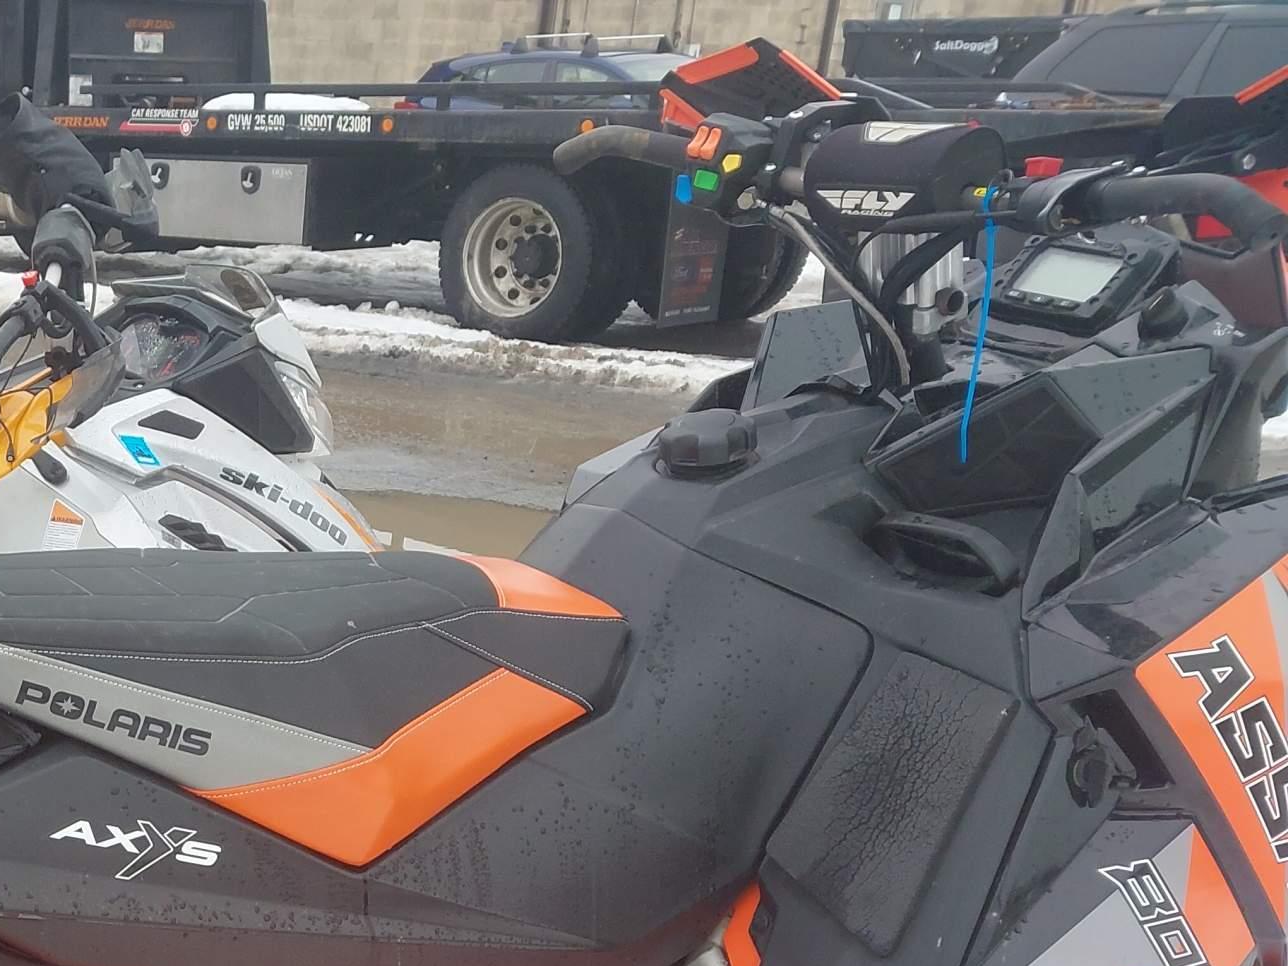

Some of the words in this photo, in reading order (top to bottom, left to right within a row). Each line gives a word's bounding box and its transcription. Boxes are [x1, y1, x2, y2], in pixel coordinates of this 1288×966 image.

[131, 108, 144, 118] CAT
[145, 108, 178, 118] RESPONSE
[179, 109, 199, 118] TEAM
[227, 113, 253, 130] GVW
[254, 114, 286, 132] 25,500
[300, 114, 335, 132] USDOT
[336, 115, 372, 132] 423081
[816, 190, 916, 211] FLY
[219, 466, 348, 547] ski-doo
[15, 680, 213, 756] POLARIS
[49, 819, 222, 880] AXYS
